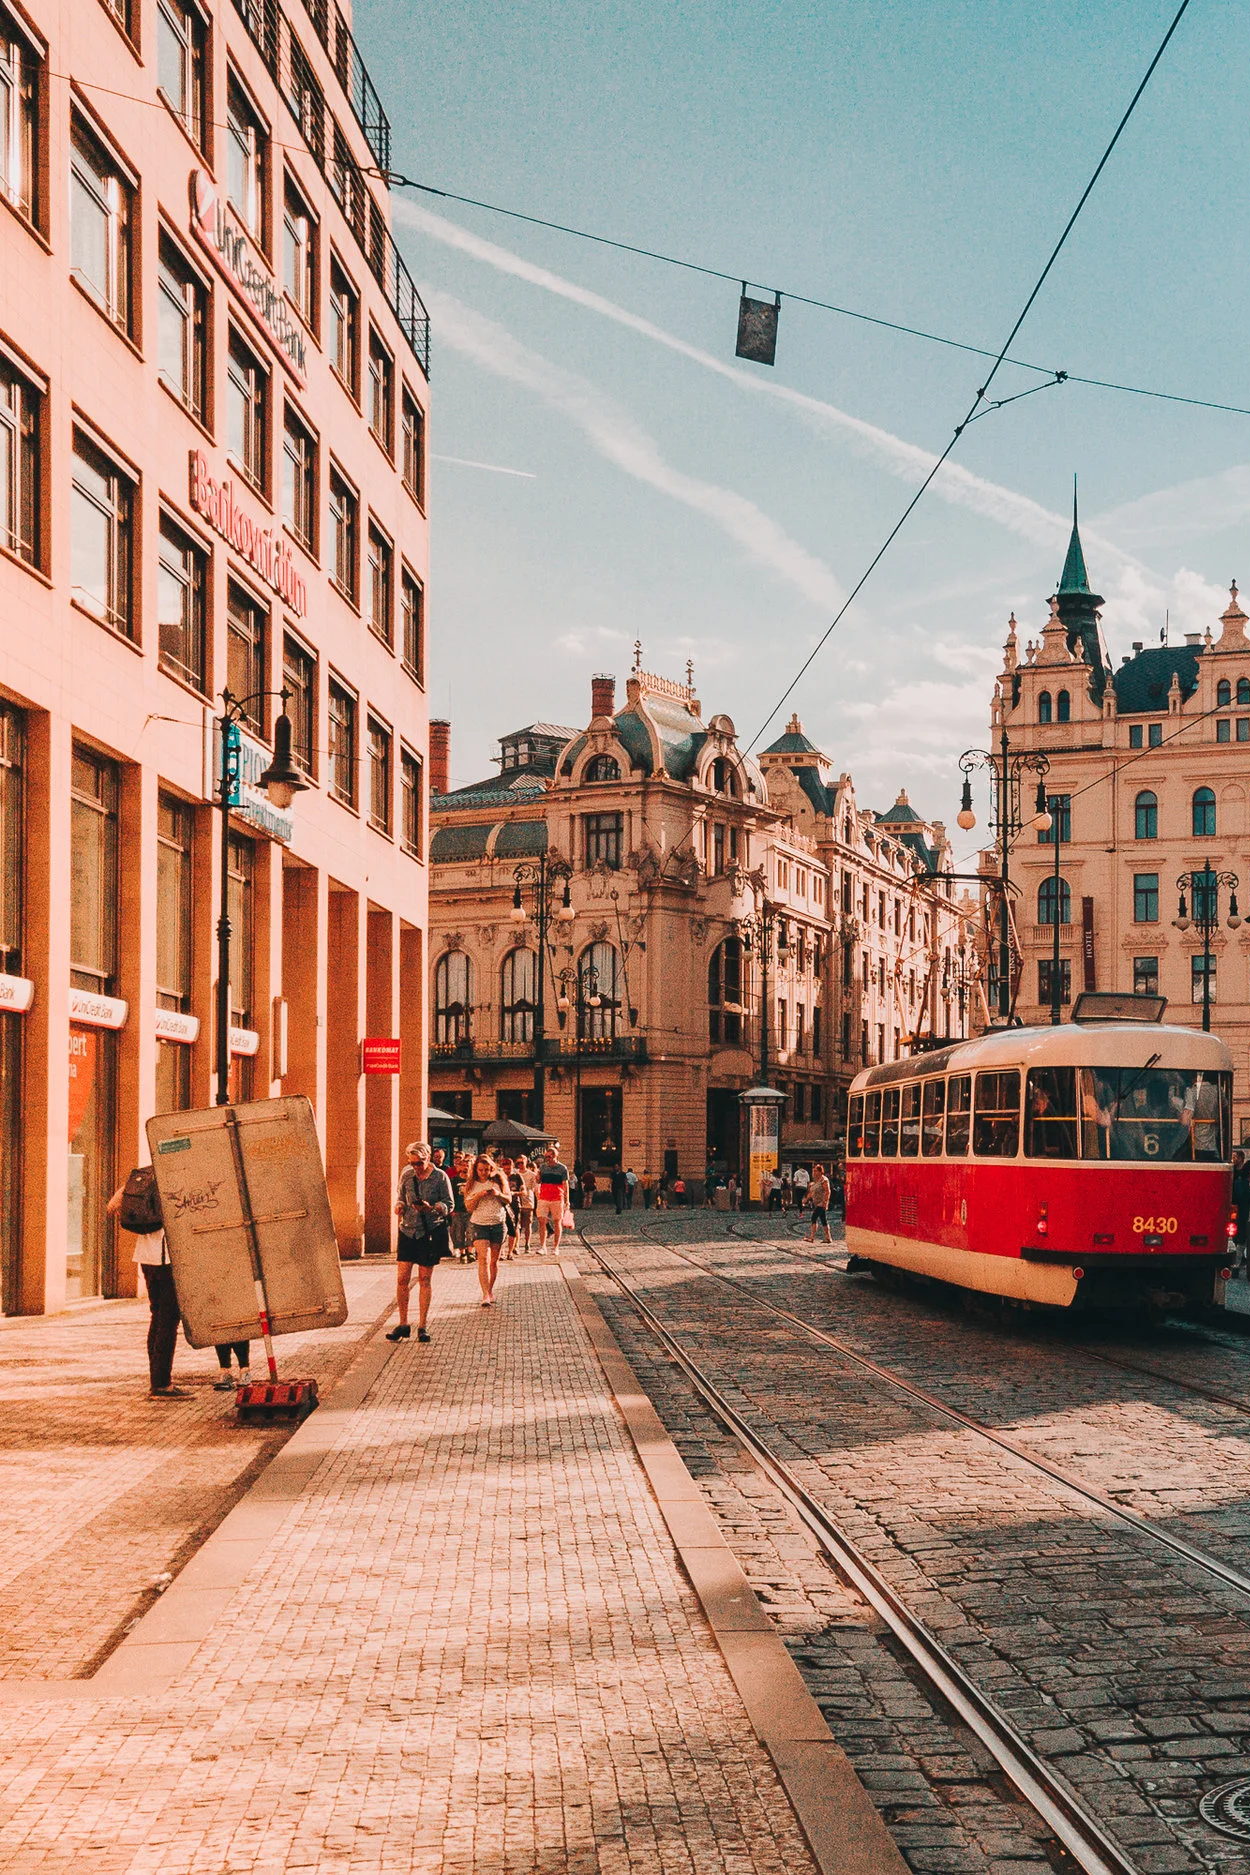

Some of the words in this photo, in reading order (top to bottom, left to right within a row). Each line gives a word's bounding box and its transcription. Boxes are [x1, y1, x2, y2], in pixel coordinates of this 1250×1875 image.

[1085, 930, 1093, 958] HOTEL
[1143, 1133, 1160, 1156] 6
[1132, 1216, 1178, 1234] 8430
